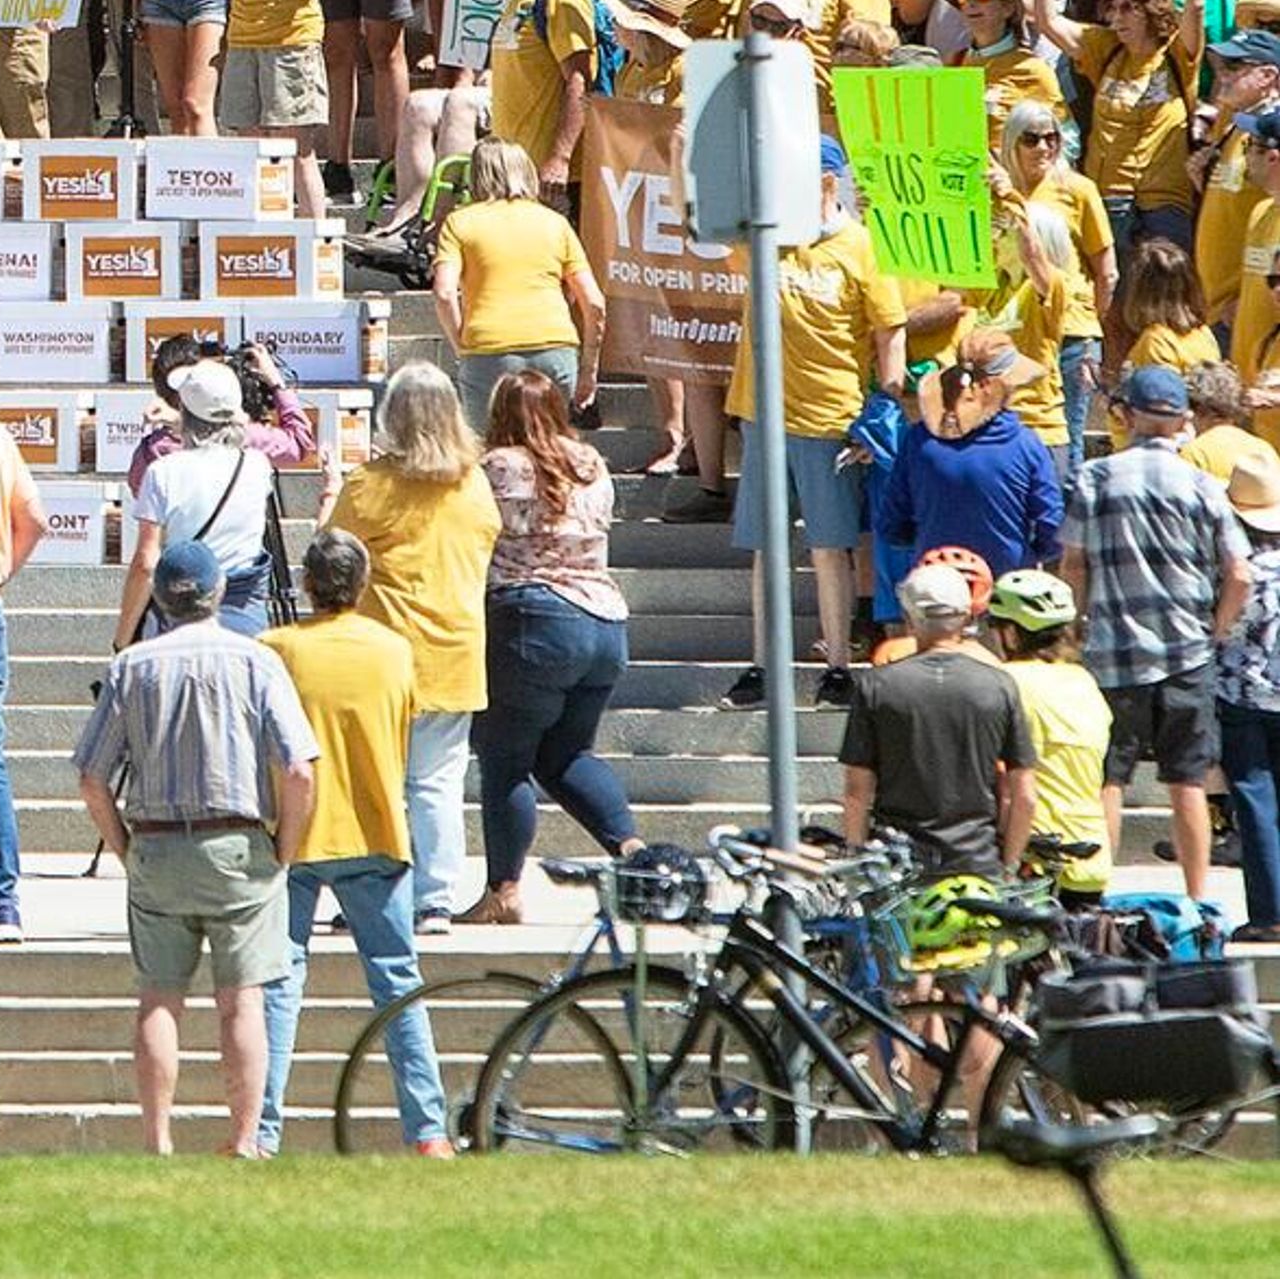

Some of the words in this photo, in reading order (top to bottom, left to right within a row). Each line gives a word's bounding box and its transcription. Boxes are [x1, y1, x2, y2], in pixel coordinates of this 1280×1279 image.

[43, 176, 85, 194] YES!
[167, 170, 233, 187] TETON
[885, 152, 926, 205] US
[87, 255, 131, 271] YES!
[220, 255, 264, 271] YES!
[608, 260, 640, 283] FOR
[644, 265, 694, 291] OPEN
[3, 332, 95, 344] WASHINGTON
[255, 331, 345, 345] BOUNDARY
